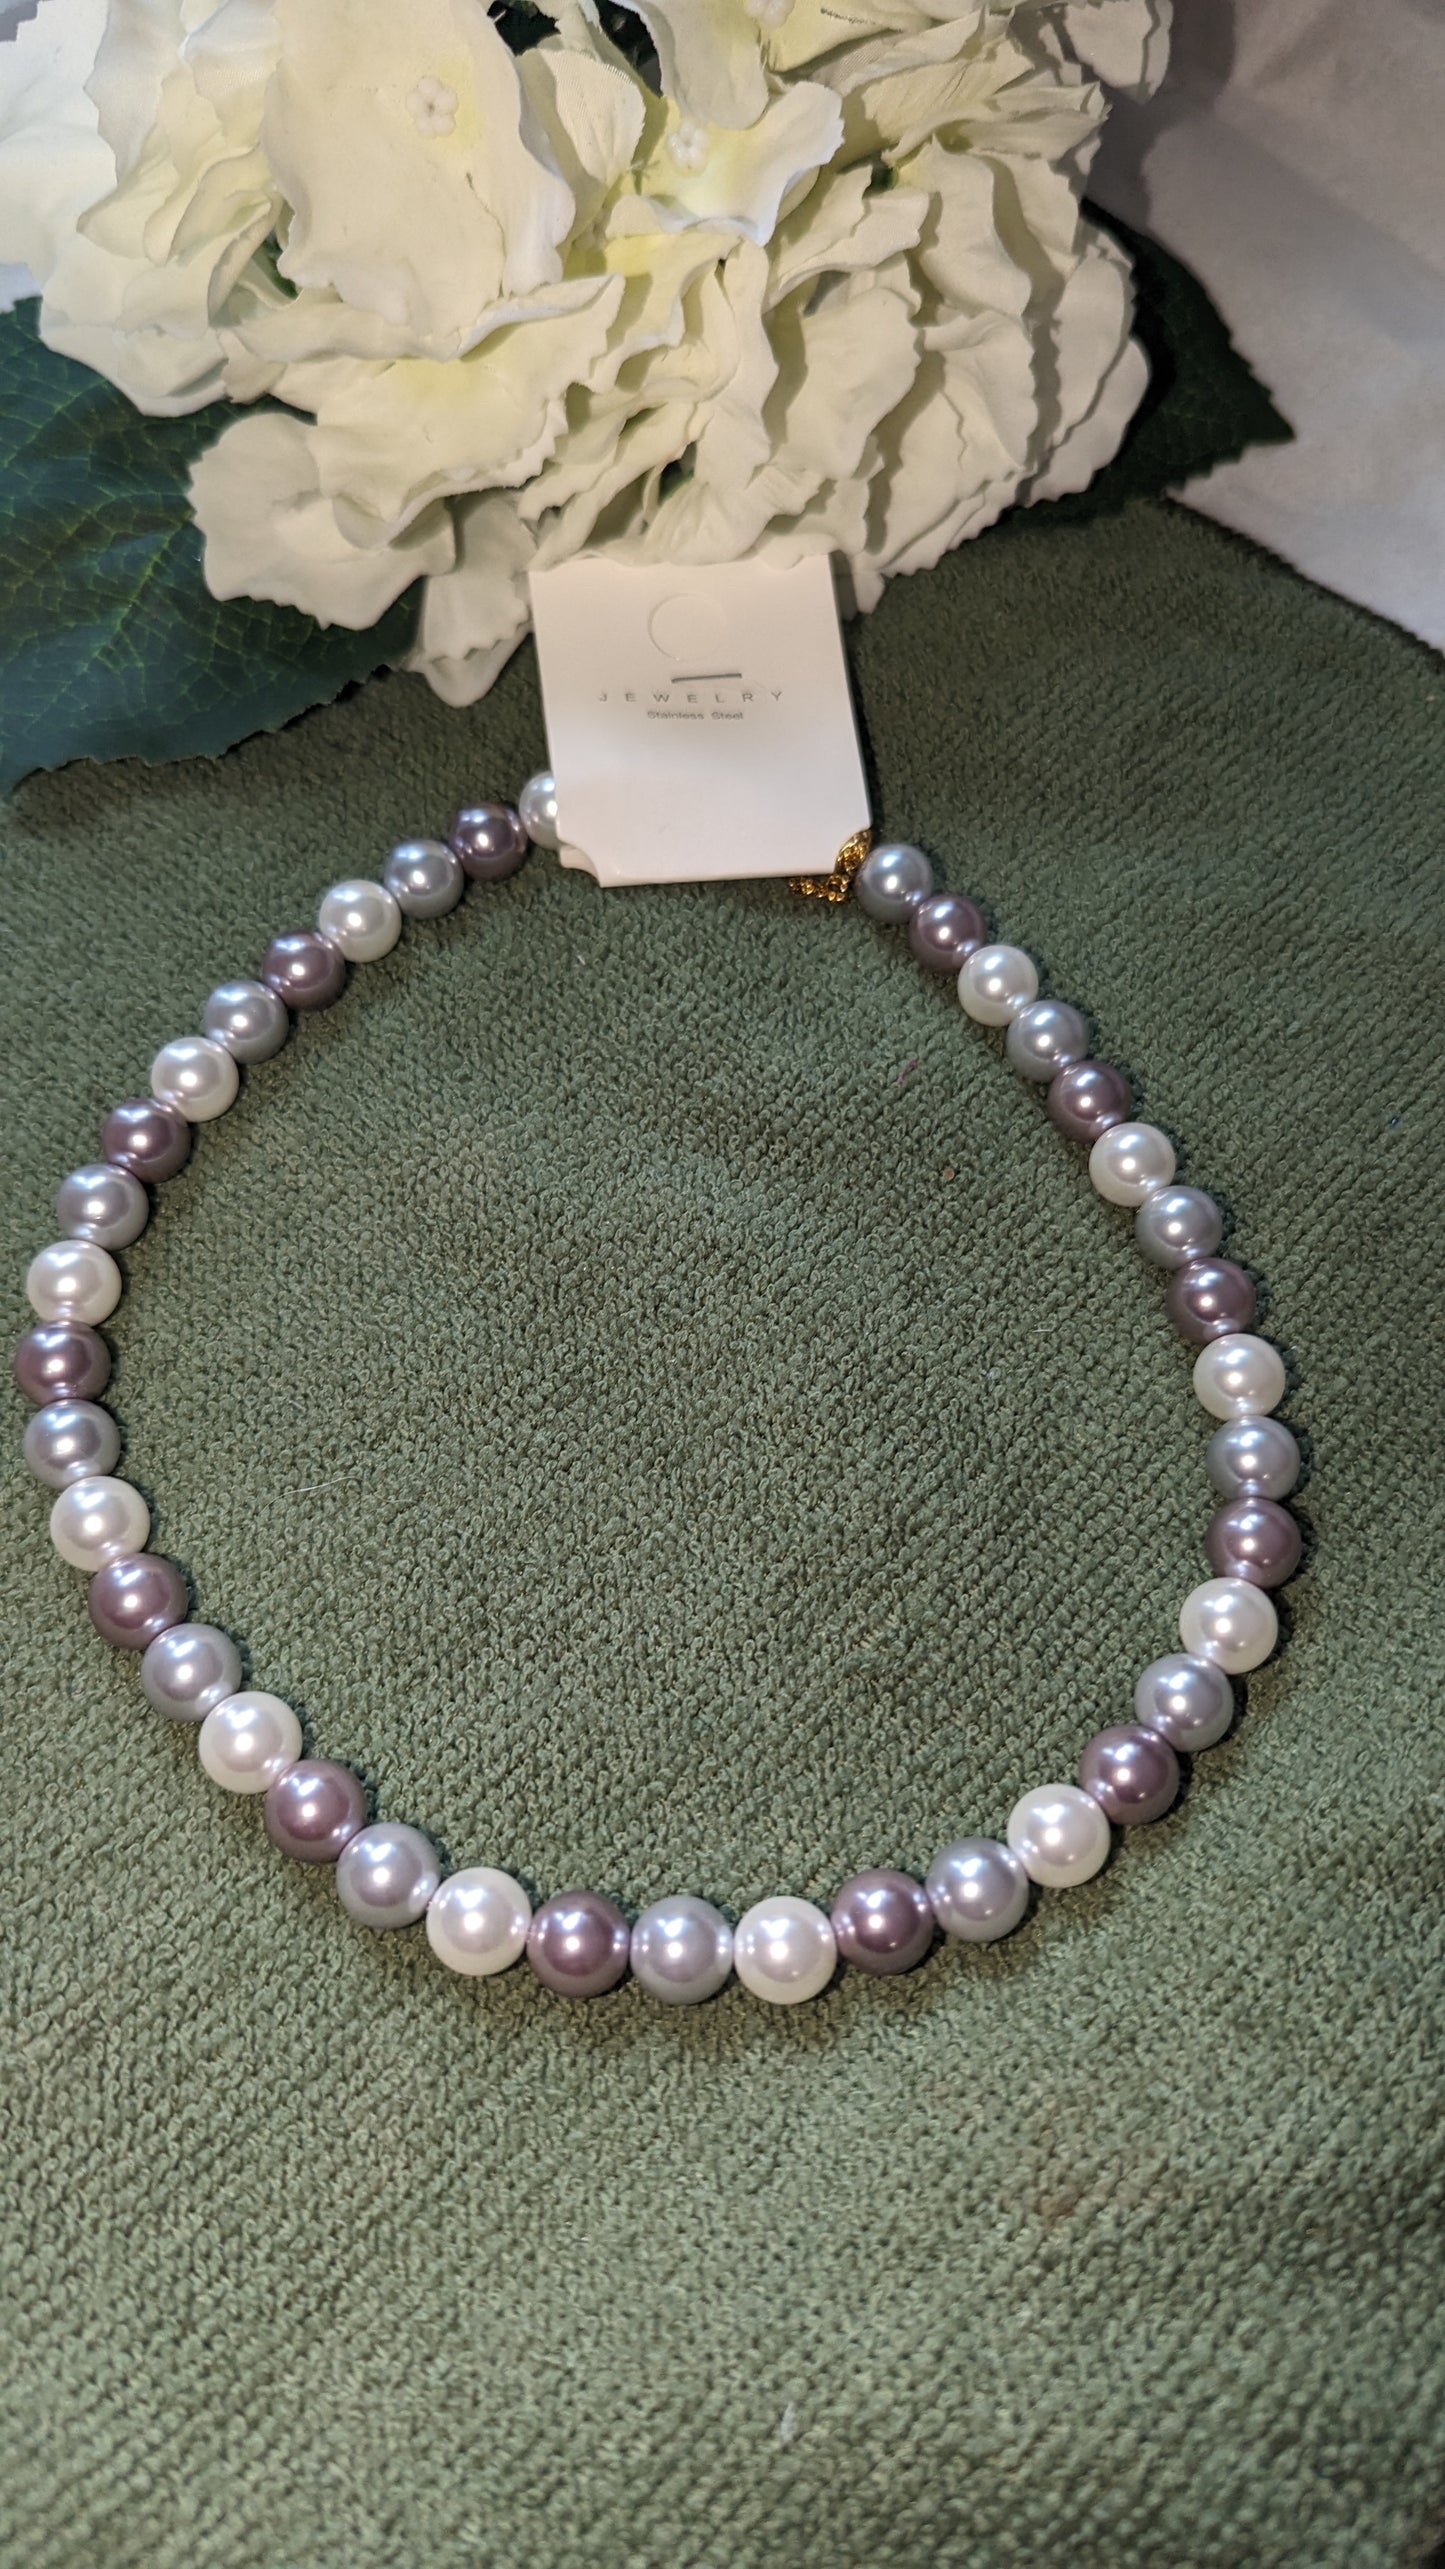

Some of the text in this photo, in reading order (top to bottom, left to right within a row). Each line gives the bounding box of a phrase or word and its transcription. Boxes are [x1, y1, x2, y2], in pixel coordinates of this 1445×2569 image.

[599, 691, 783, 703] JEWELRY
[647, 711, 744, 720] Stainless Steel
